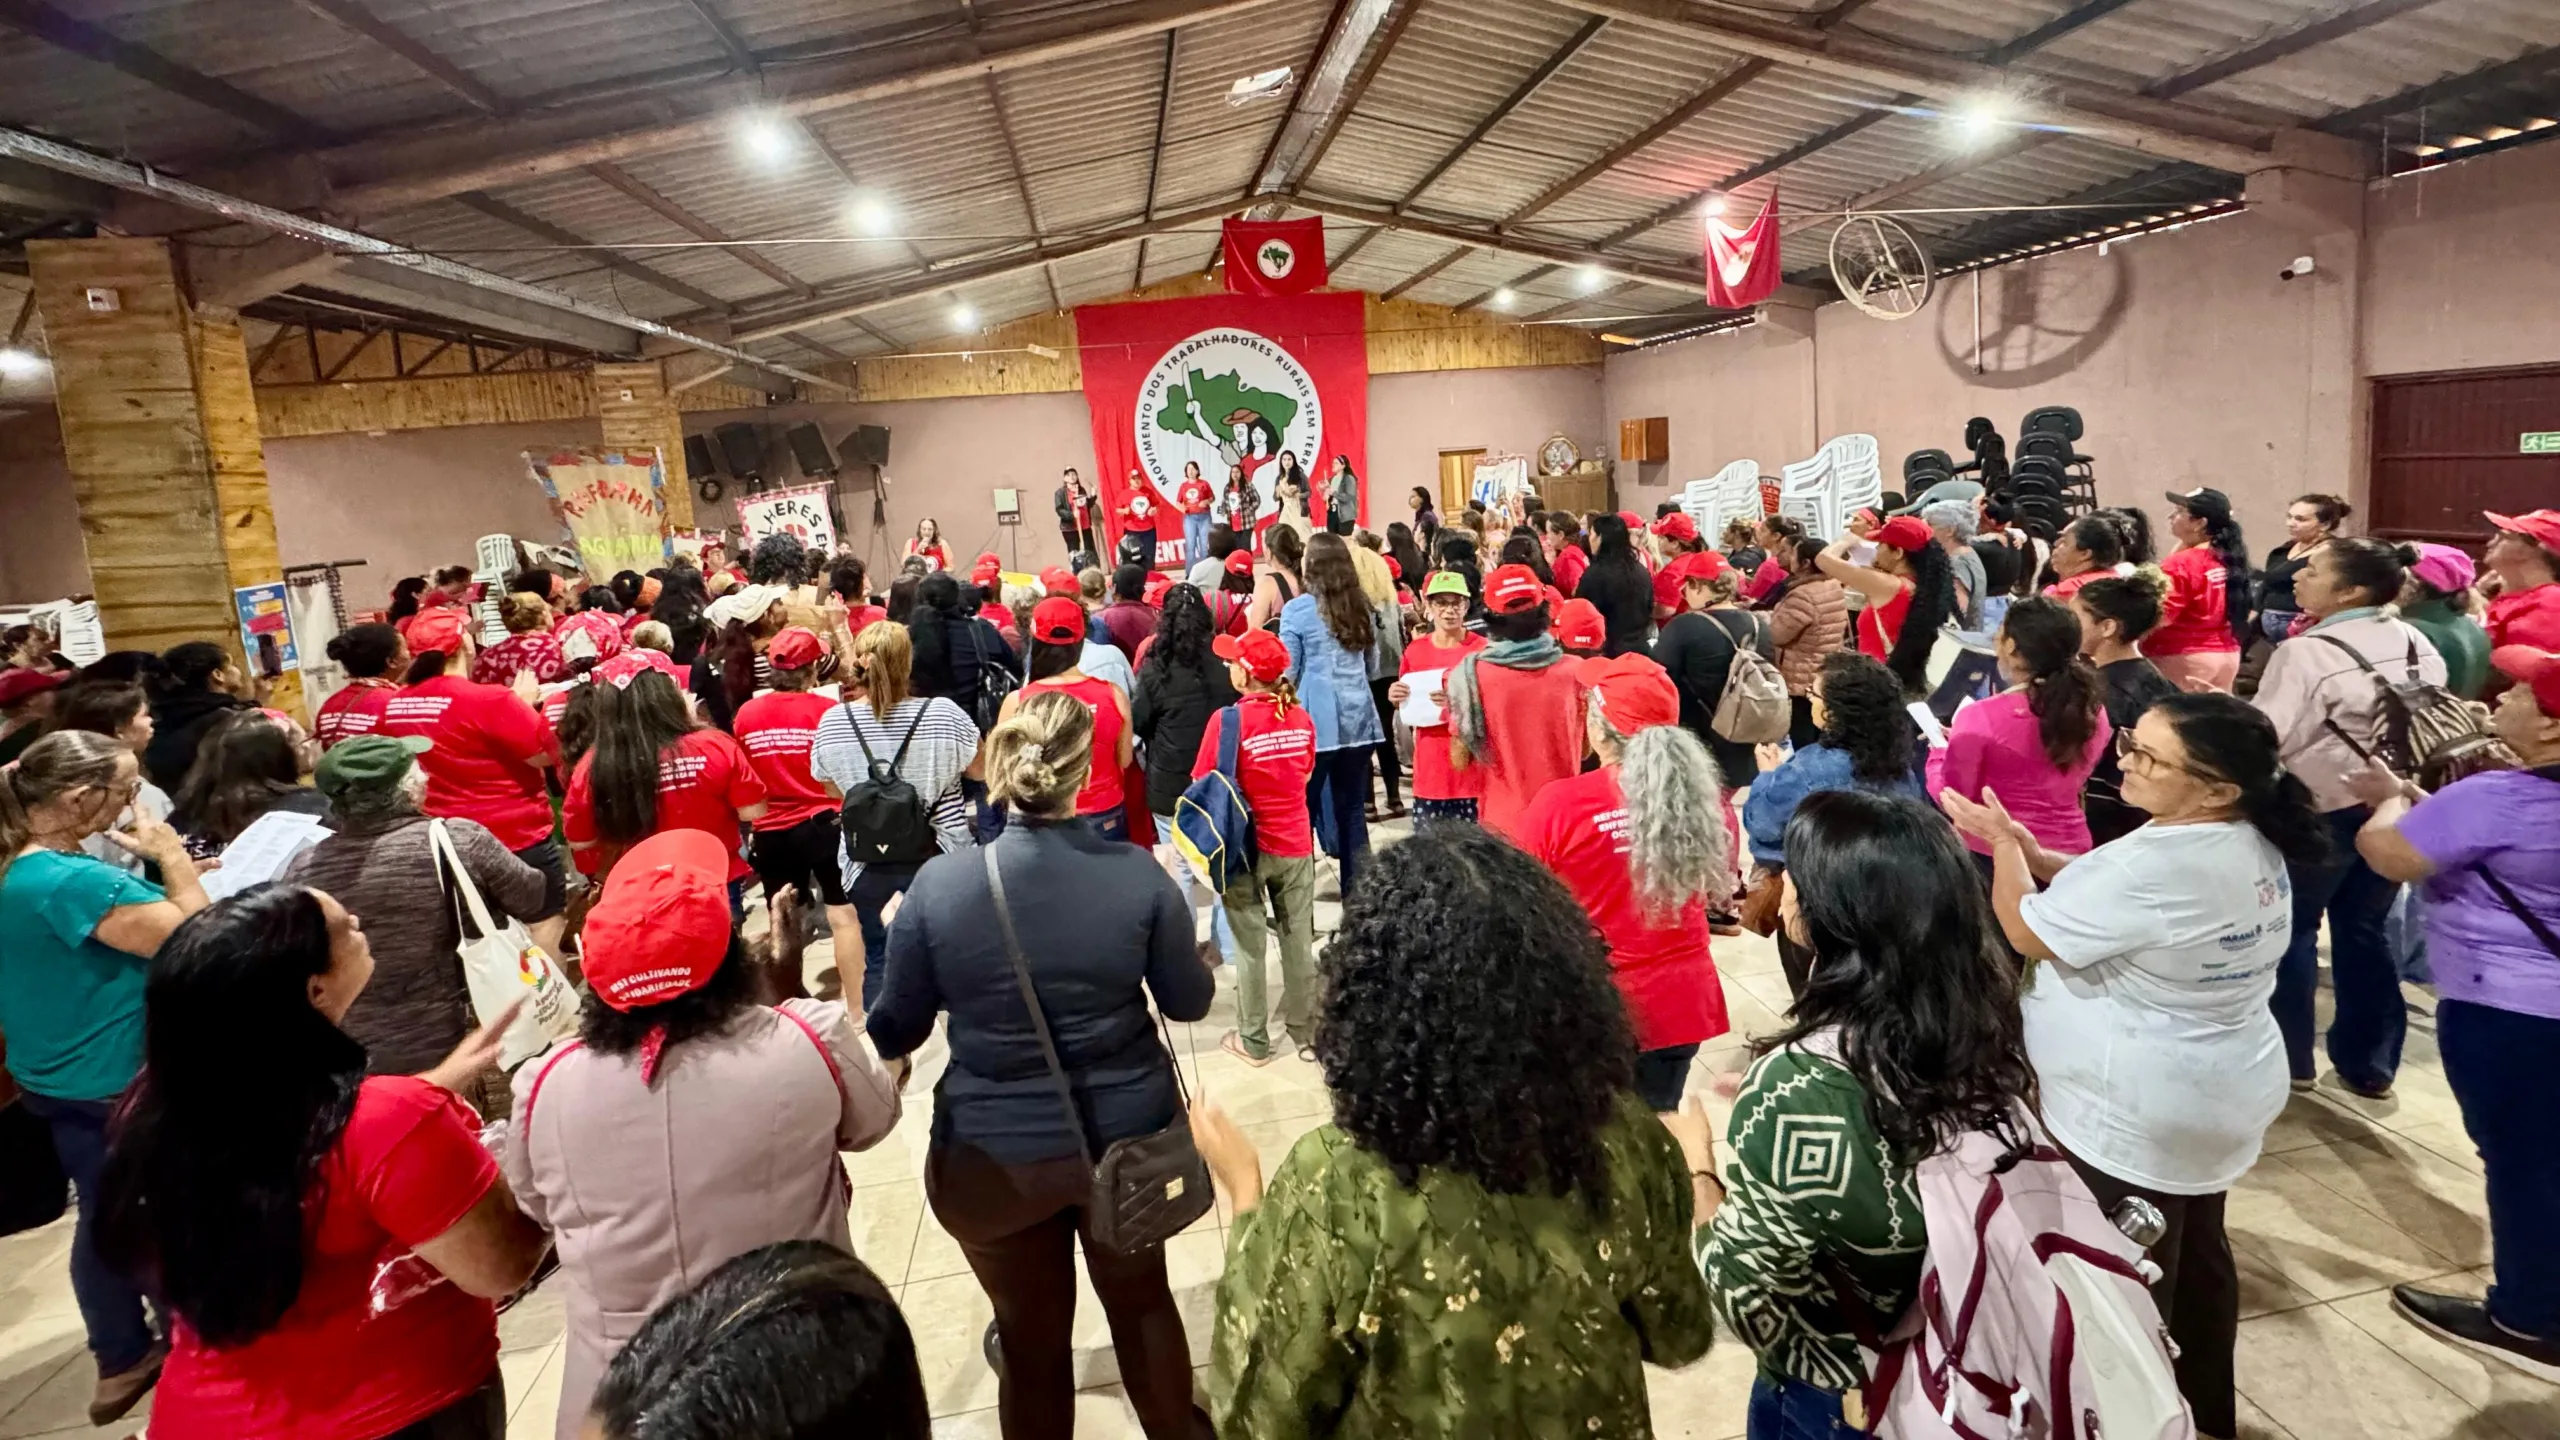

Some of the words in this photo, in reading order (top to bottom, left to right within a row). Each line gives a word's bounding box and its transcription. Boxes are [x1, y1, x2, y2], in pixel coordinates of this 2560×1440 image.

[1164, 334, 1273, 370] TRABALHADORES
[1147, 371, 1165, 398] DOS
[1275, 355, 1310, 397] RURAIS
[1305, 401, 1316, 428] SEM
[1141, 403, 1170, 486] MOVIMENTO
[1300, 435, 1315, 468] TERR
[757, 500, 822, 537] LHERES
[610, 977, 629, 994] MST
[628, 967, 691, 984] CULTIVANDO
